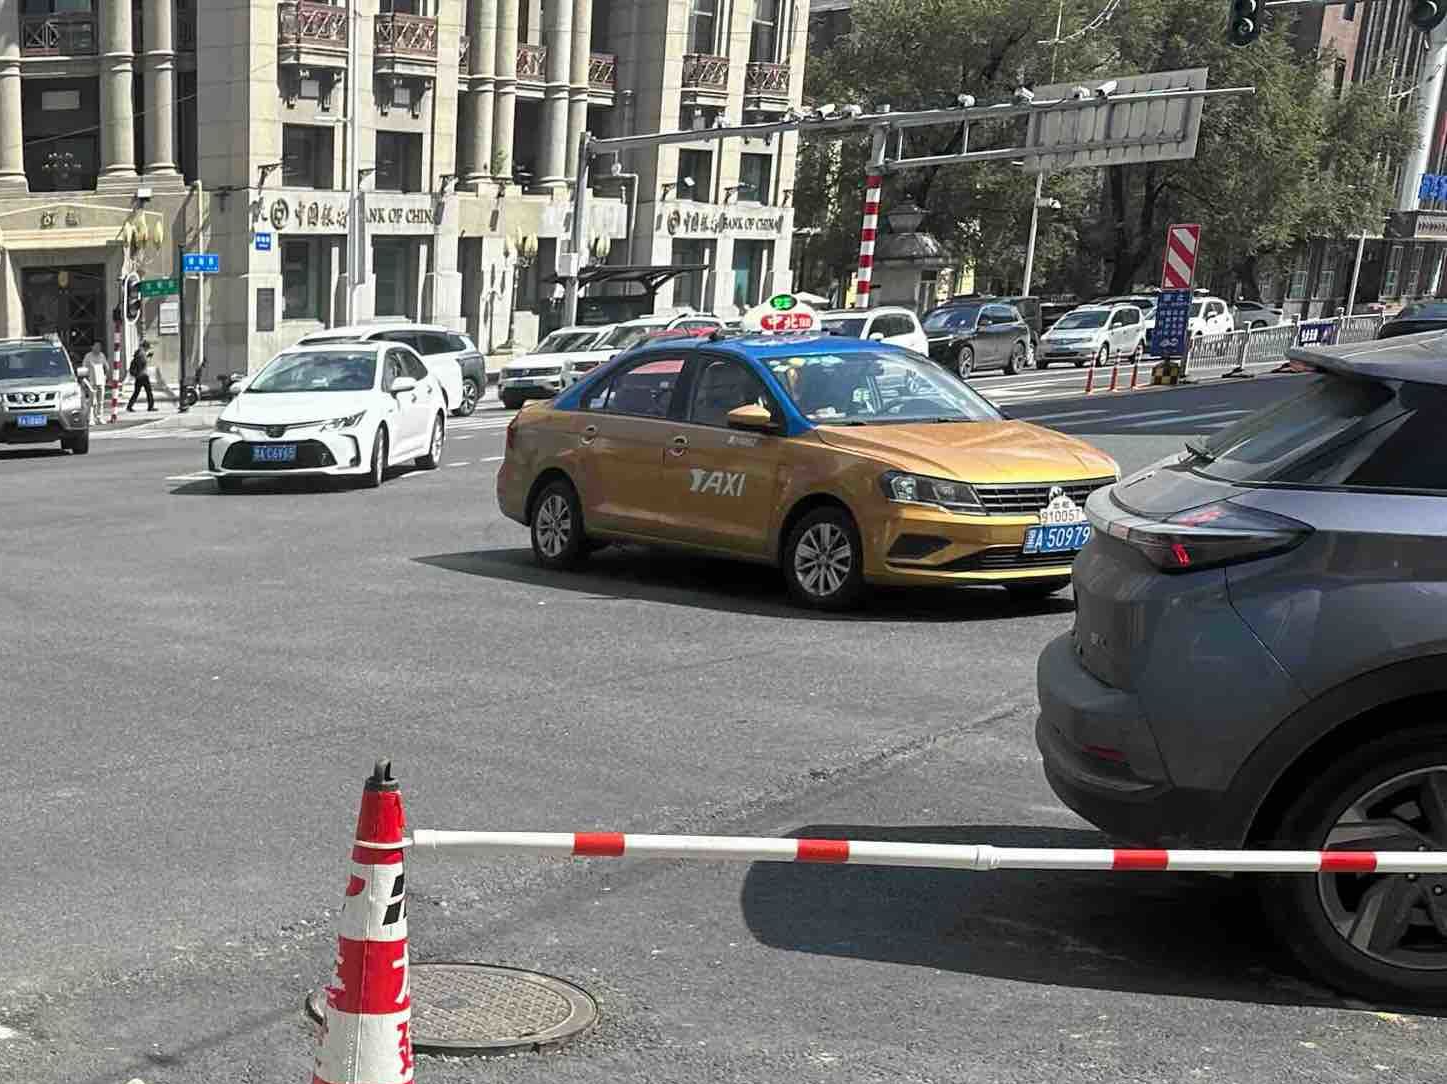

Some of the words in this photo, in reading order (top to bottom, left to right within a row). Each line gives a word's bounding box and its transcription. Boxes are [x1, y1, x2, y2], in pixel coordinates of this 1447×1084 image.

[363, 207, 386, 225] ANK
[388, 207, 403, 225] OF
[689, 468, 746, 497] TAXI
[1041, 510, 1081, 523] 910057
